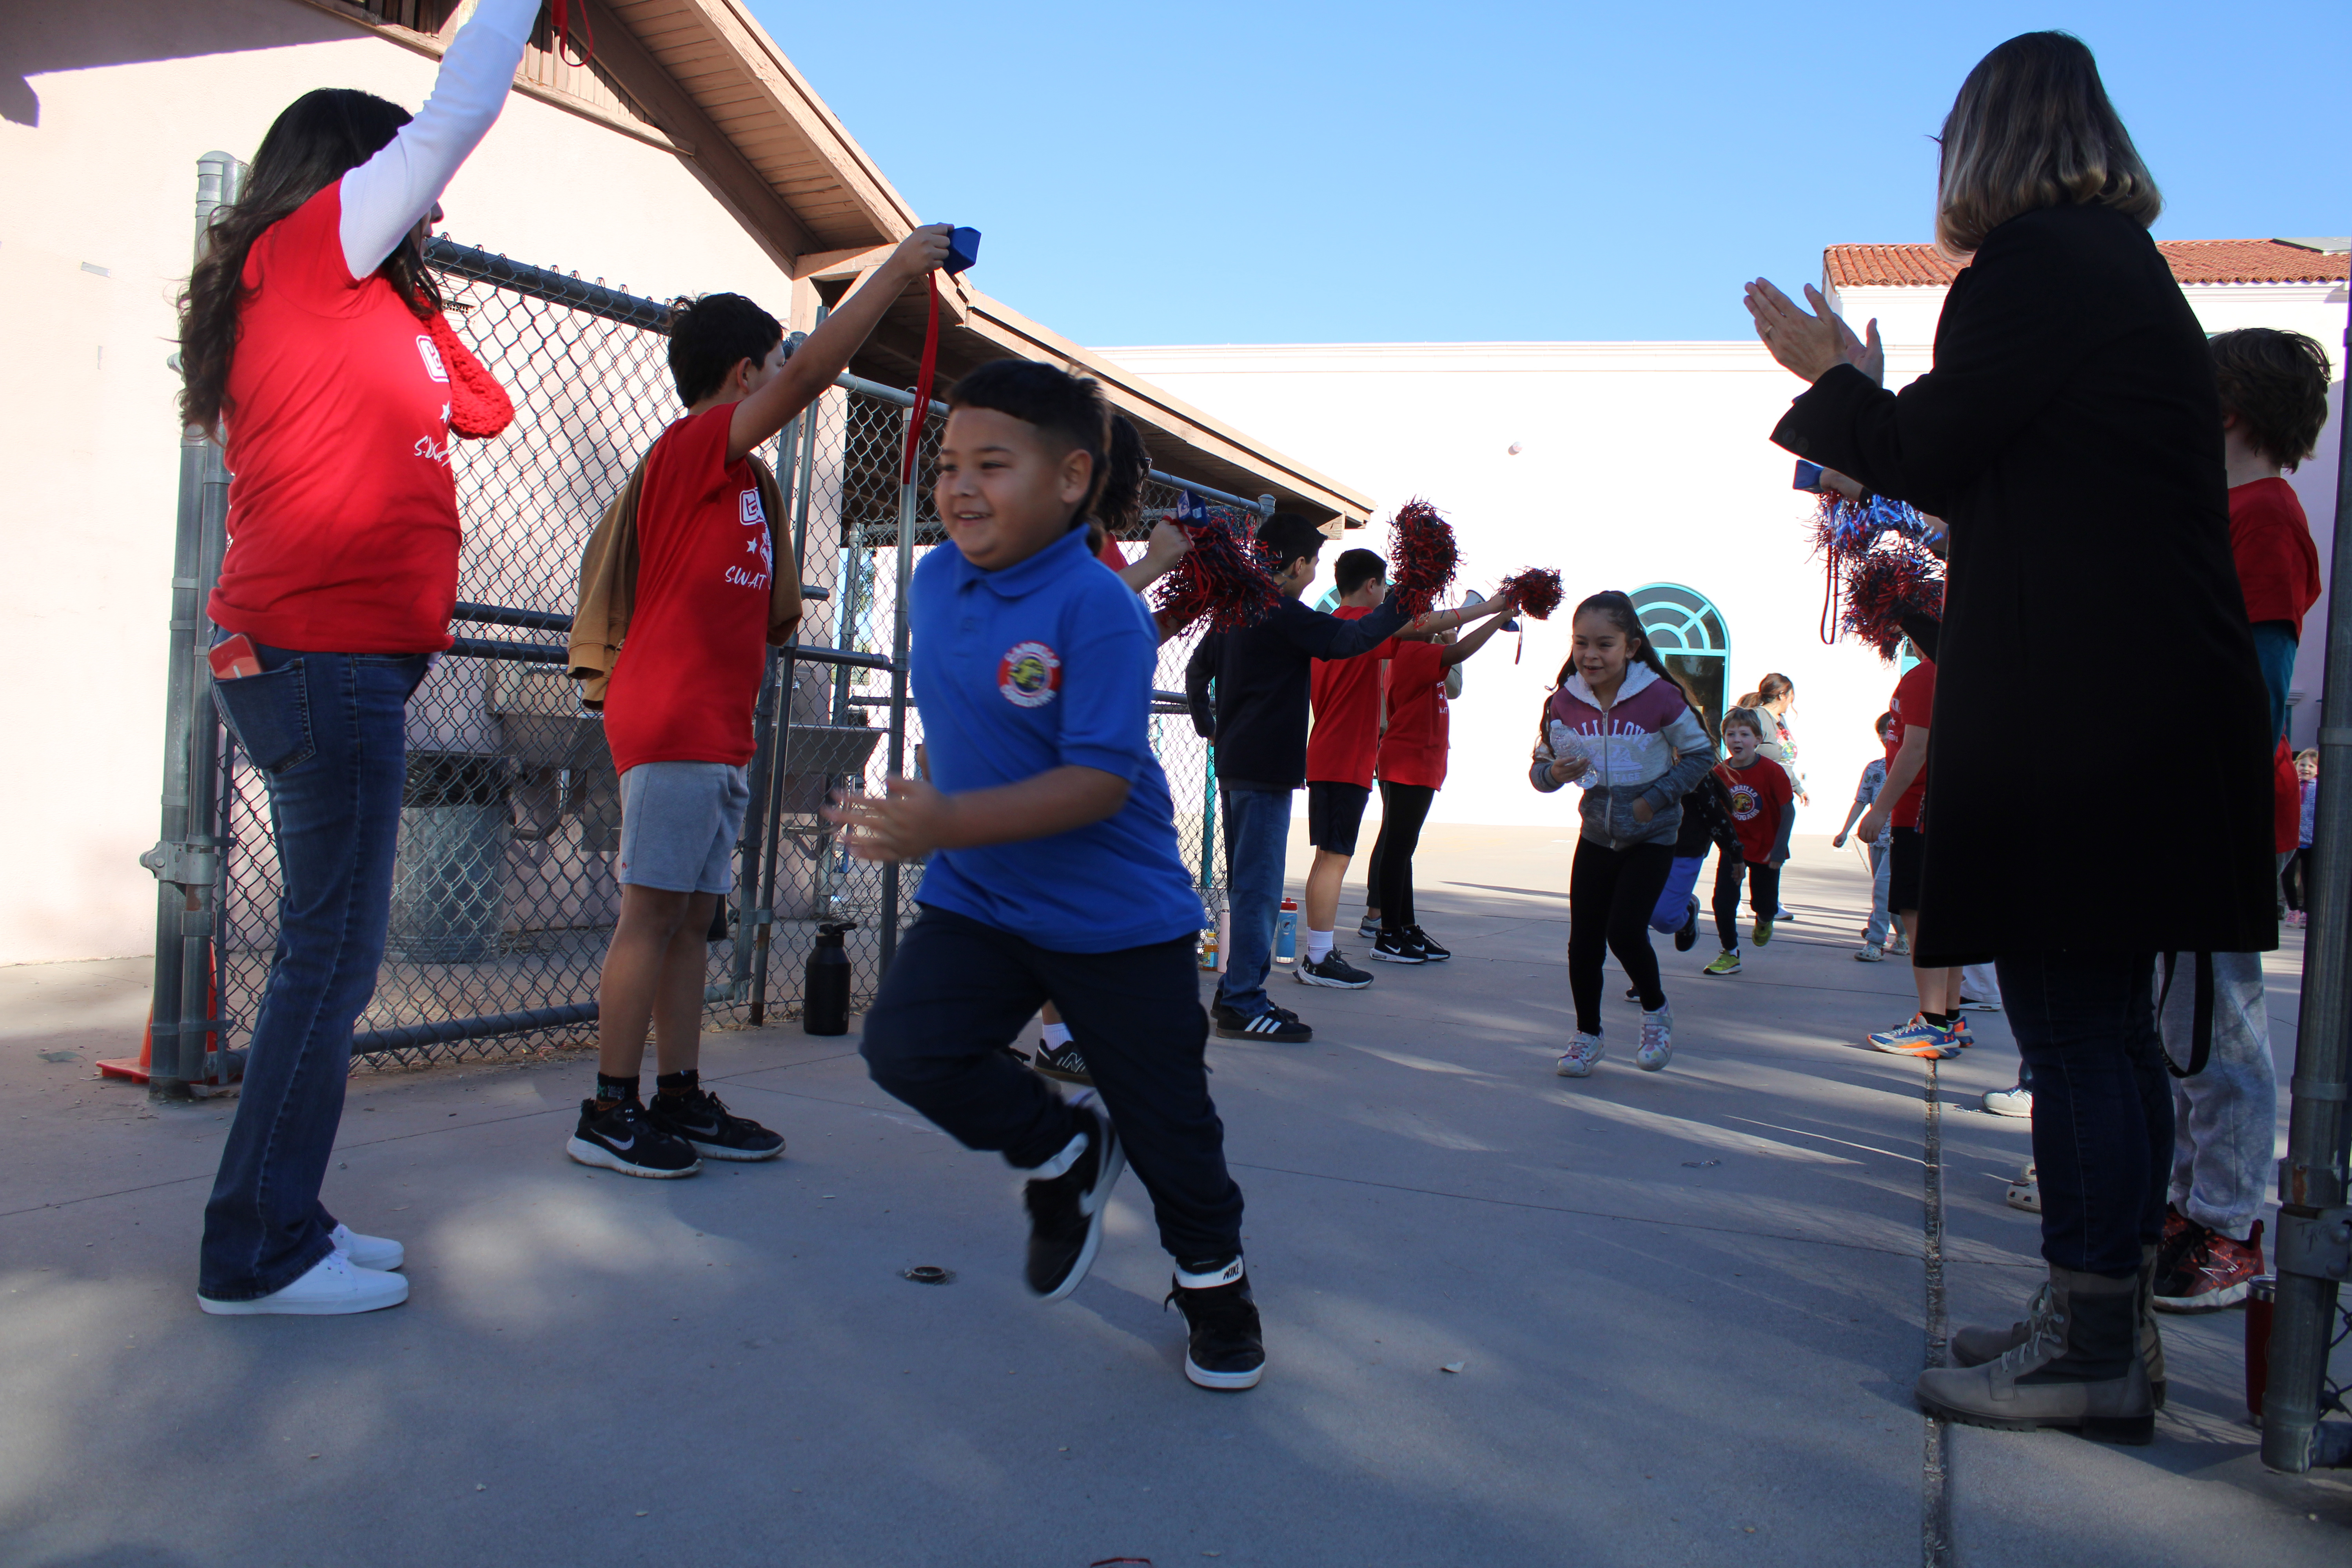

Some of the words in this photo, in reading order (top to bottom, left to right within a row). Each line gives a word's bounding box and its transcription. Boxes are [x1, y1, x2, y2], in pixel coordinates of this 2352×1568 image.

[1612, 719, 1654, 752] LOVE
[1613, 772, 1641, 783] TAGE
[1730, 785, 1758, 798] ARRILLO
[1733, 809, 1760, 821] OUGARS
[1223, 1263, 1239, 1280] NIKE
